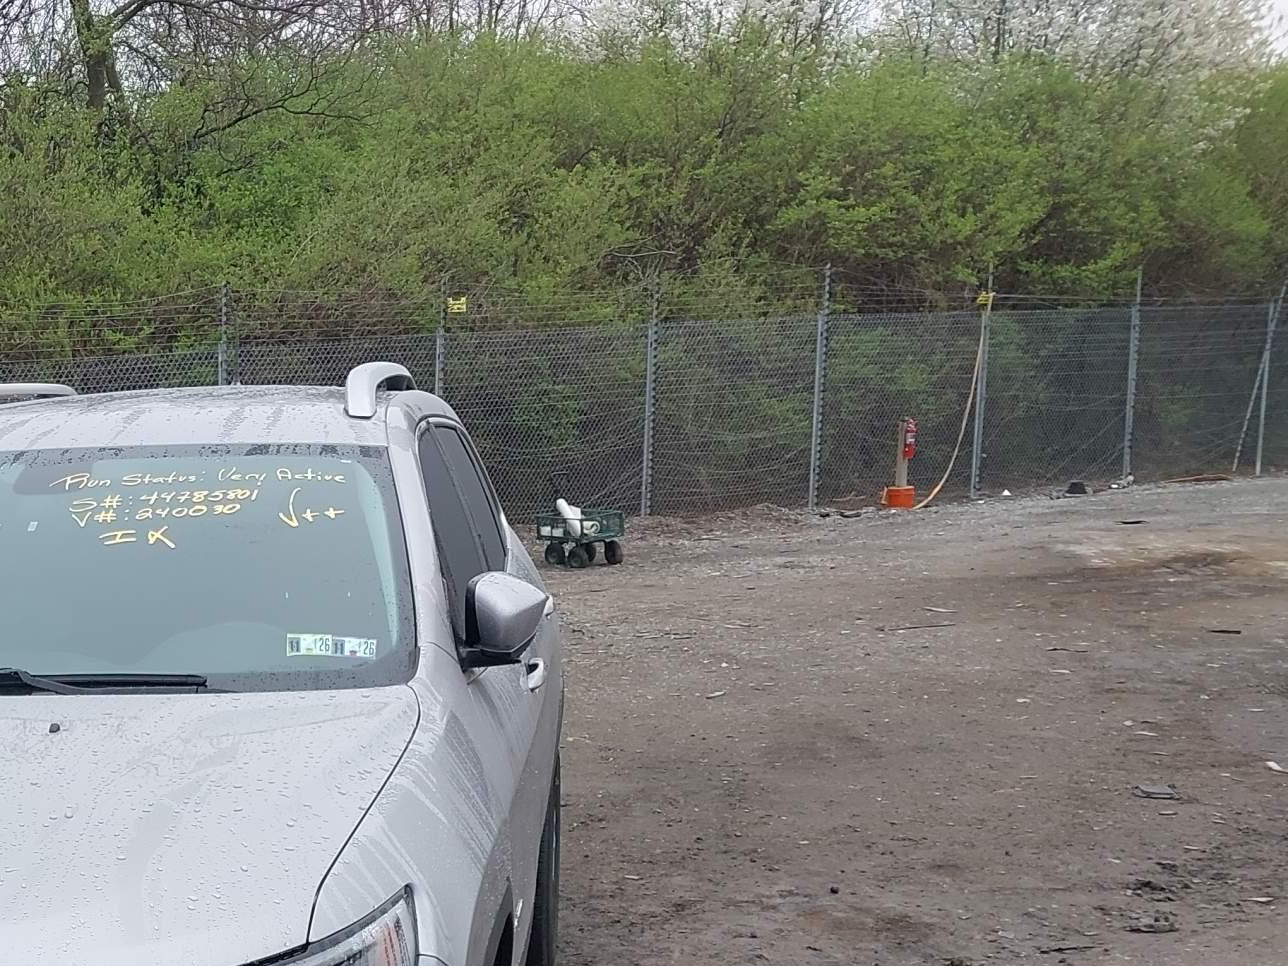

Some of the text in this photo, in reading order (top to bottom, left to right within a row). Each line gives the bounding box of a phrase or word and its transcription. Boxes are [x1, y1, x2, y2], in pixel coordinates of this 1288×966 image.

[49, 473, 112, 491] Run
[120, 471, 207, 487] Status:
[276, 468, 346, 483] Active
[139, 488, 259, 505] 44785801
[318, 637, 330, 652] 26
[363, 640, 375, 656] 26
